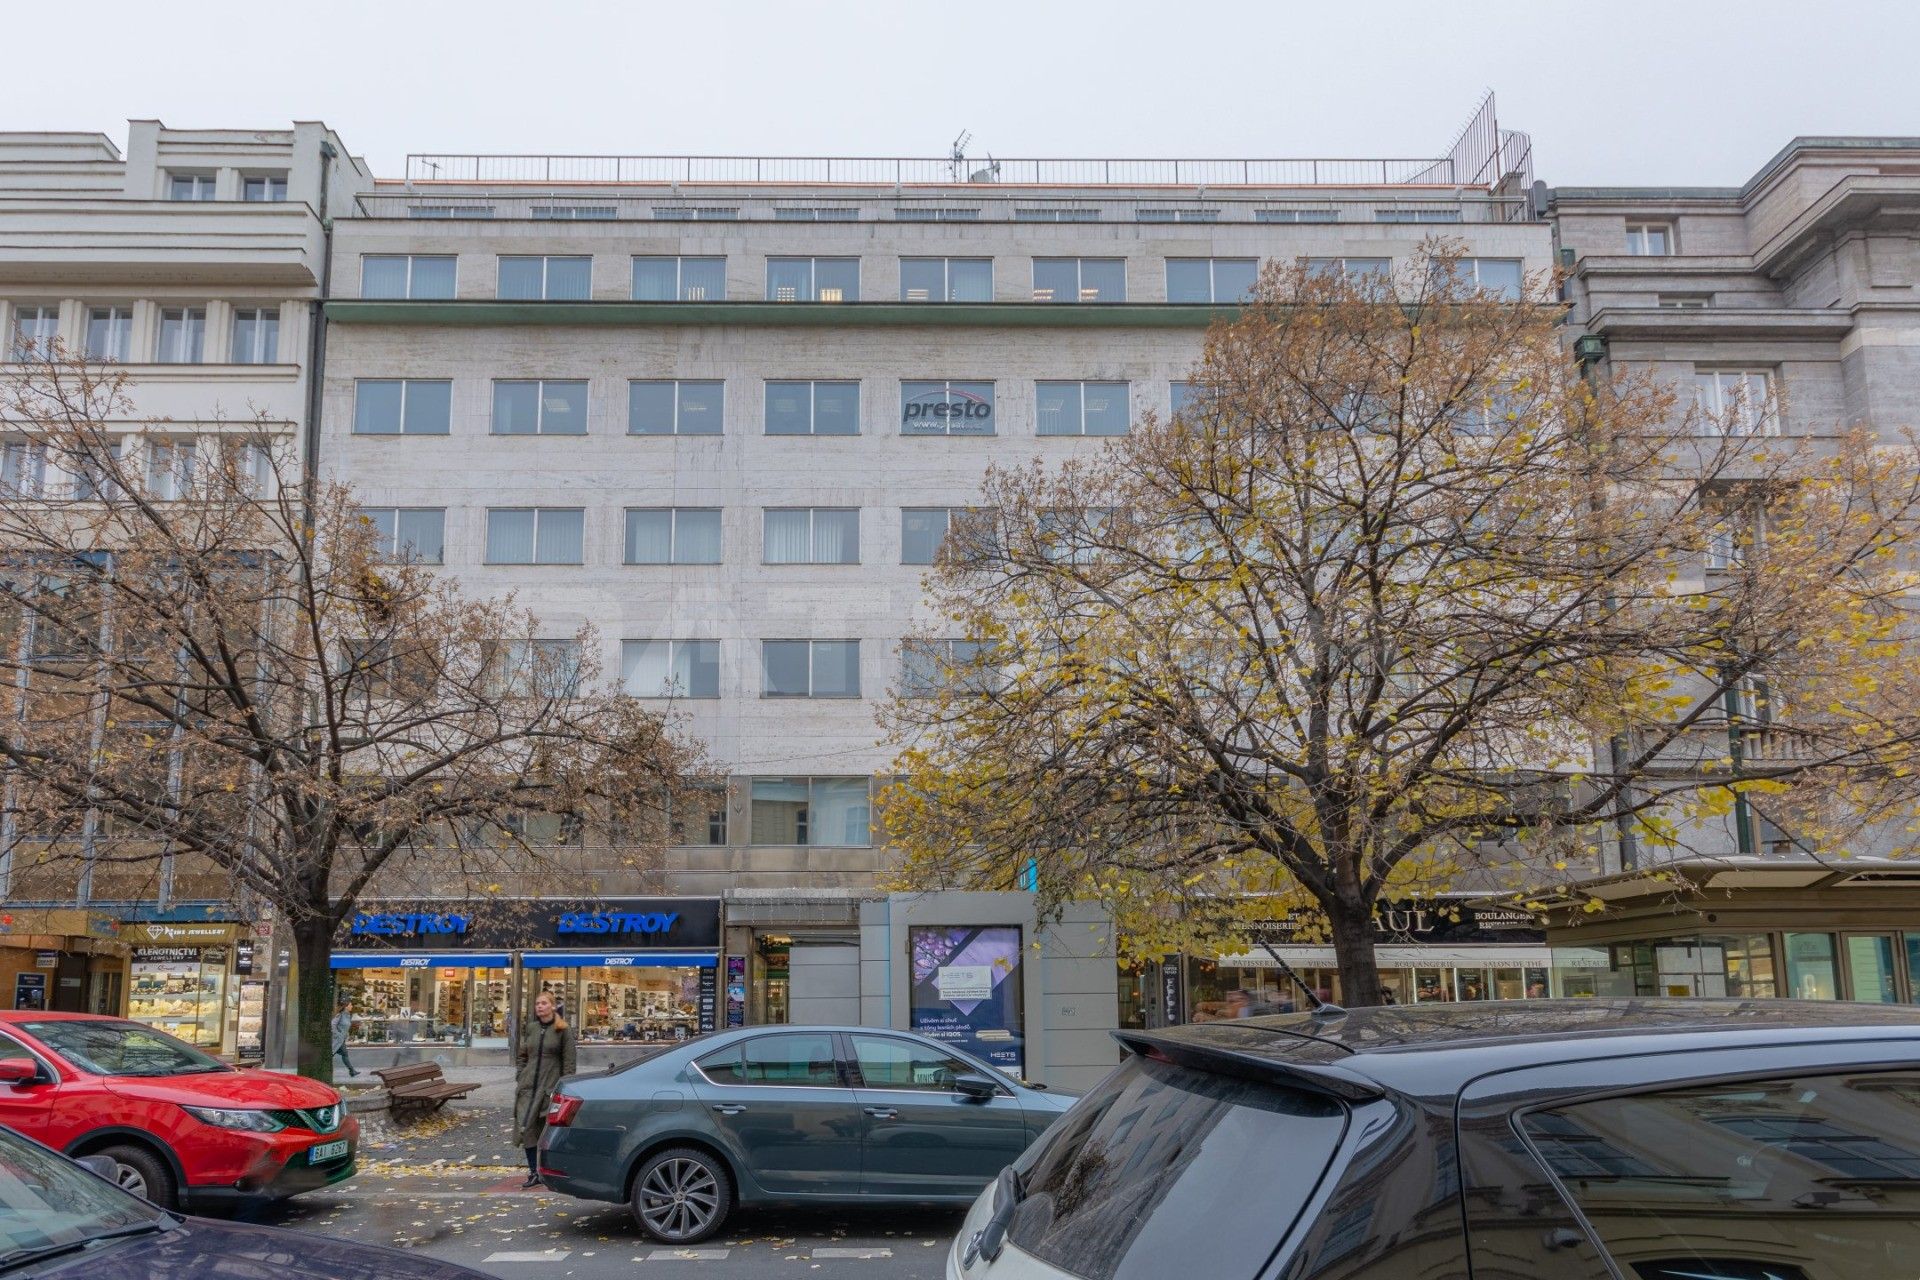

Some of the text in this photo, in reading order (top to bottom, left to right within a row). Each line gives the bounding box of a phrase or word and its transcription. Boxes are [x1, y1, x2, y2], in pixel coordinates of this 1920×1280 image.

[903, 400, 991, 422] presto
[351, 912, 473, 934] DESTROY
[558, 912, 680, 934] DESTROY
[1371, 910, 1435, 932] AUL
[400, 958, 430, 966] DESTROY
[605, 957, 634, 965] DESTROY
